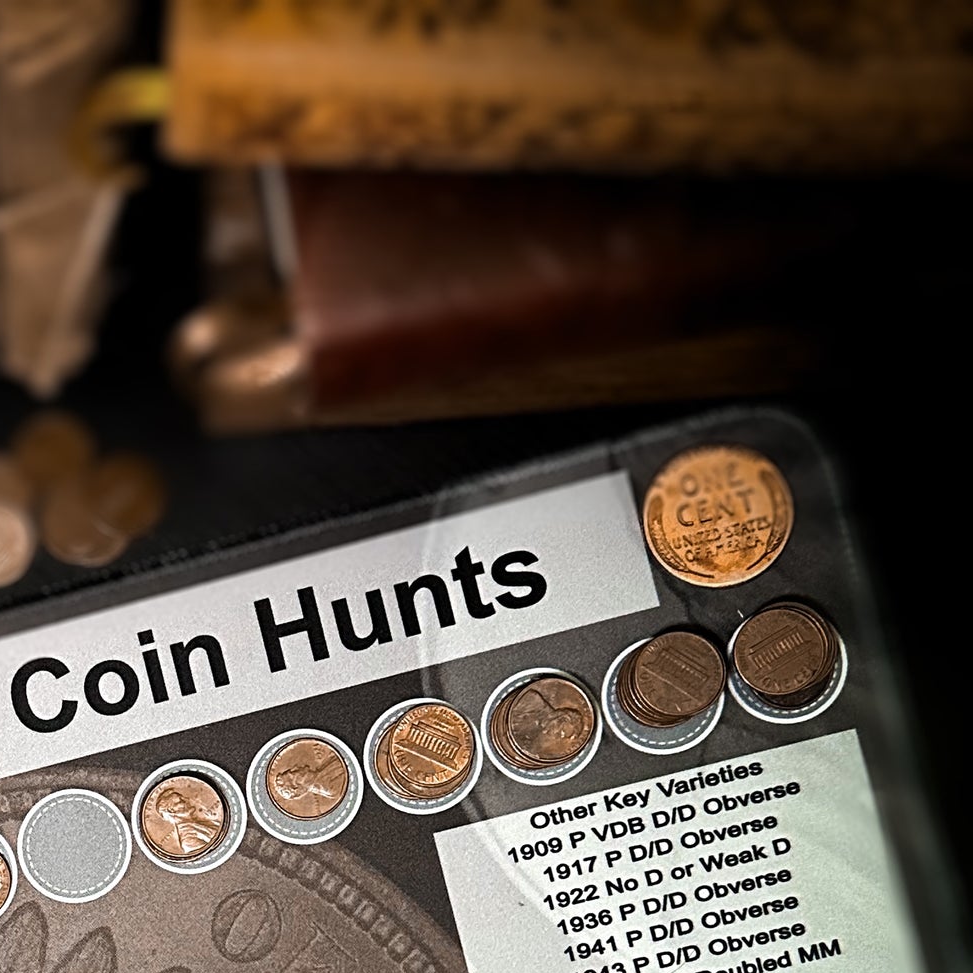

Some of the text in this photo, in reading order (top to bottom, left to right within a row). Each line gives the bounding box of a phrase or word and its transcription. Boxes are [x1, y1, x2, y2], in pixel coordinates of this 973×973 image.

[676, 487, 755, 527] CENT
[11, 628, 230, 733] Coin
[254, 545, 547, 673] Hunts
[508, 782, 800, 863] 1909 P VDB D/D Obverse
[530, 762, 763, 829] Other Key Varieties
[544, 816, 778, 882] 1917 P D/D Obverse
[544, 838, 791, 910] 1922 No D or Weak D
[557, 870, 792, 935] 1936 P D/D Obverse
[564, 897, 799, 961] 1941 P D/D Obverse
[633, 957, 649, 973] P
[656, 945, 701, 968] D/D
[708, 923, 806, 955] Obverse
[798, 939, 841, 963] MM
